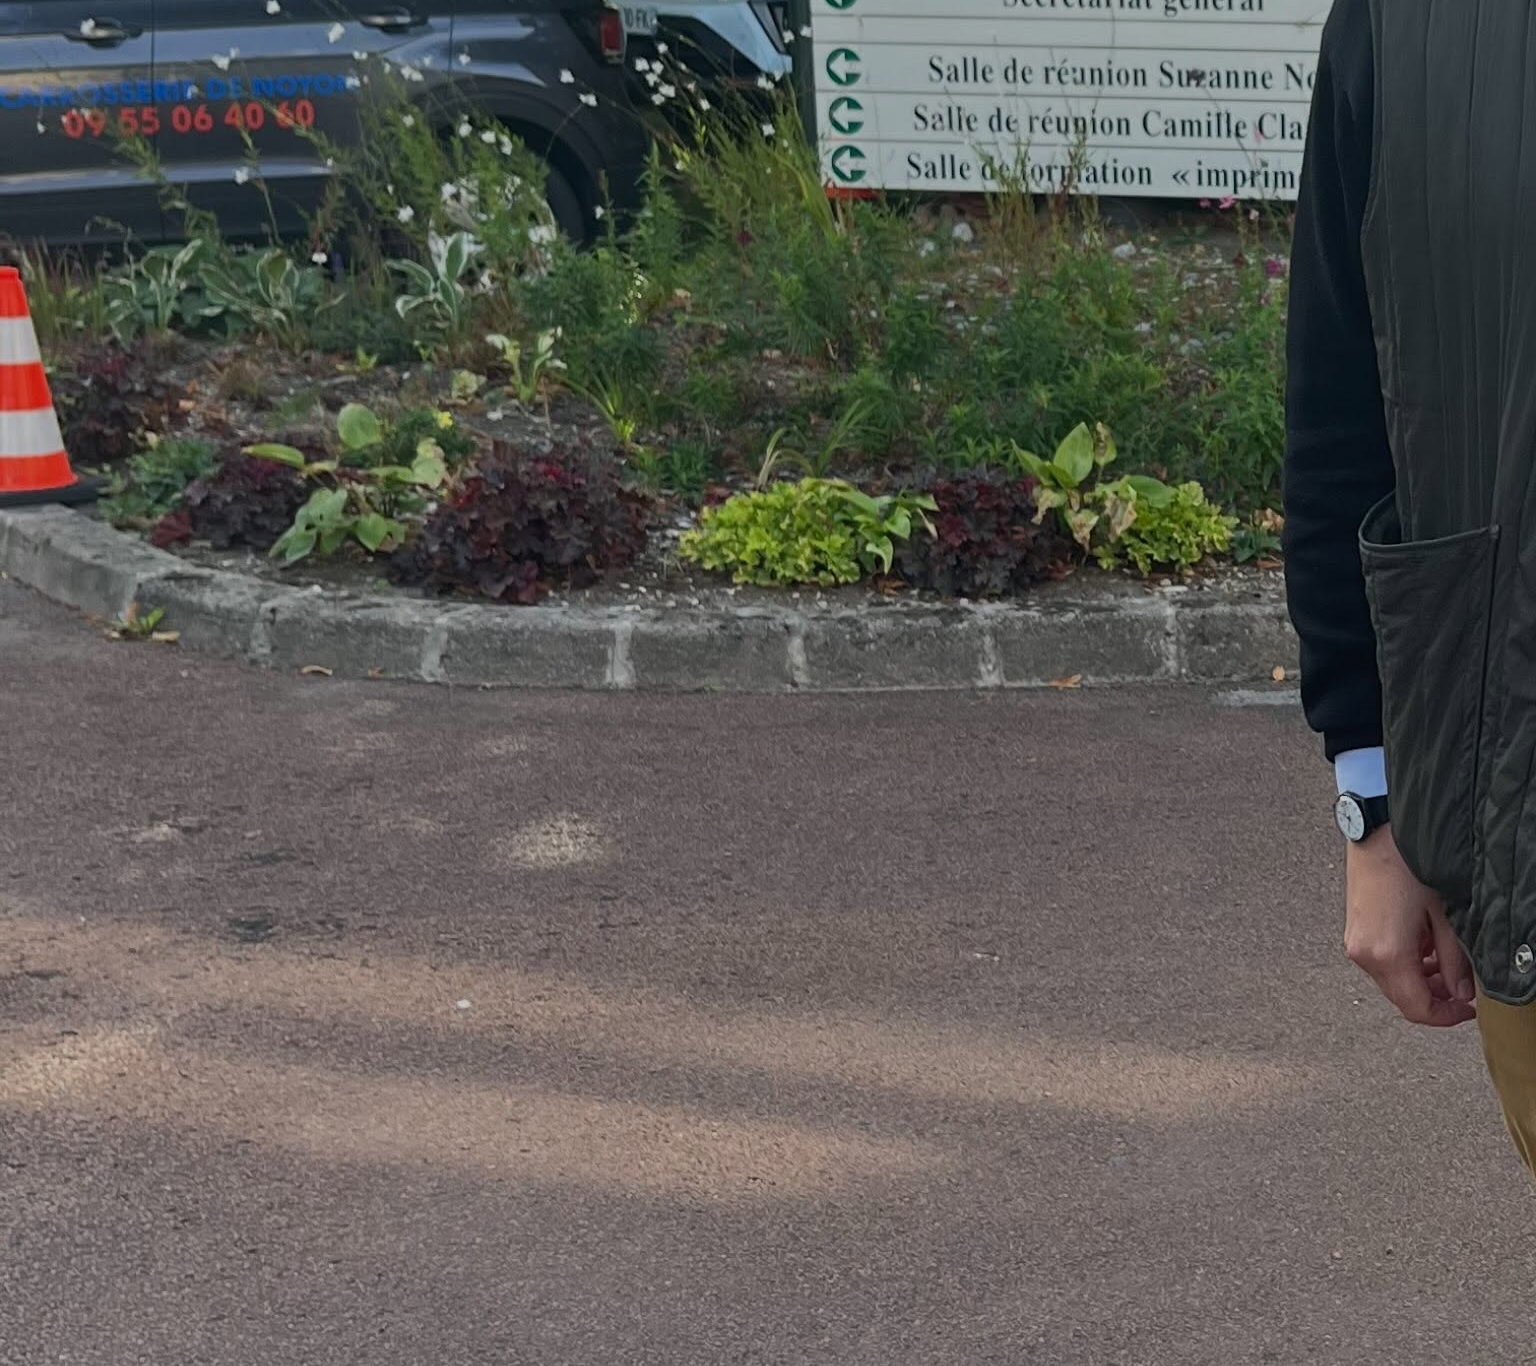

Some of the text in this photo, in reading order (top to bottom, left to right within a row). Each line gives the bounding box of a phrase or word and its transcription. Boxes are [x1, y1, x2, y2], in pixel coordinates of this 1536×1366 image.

[928, 55, 994, 85] Salle
[1004, 57, 1034, 85] de
[1044, 58, 1147, 88] réunion
[1159, 61, 1273, 90] Suzanne
[63, 99, 315, 139] 09 55 06 40 60
[913, 104, 1303, 140] Salle de réunion Camille Cla
[907, 153, 970, 181] Salle
